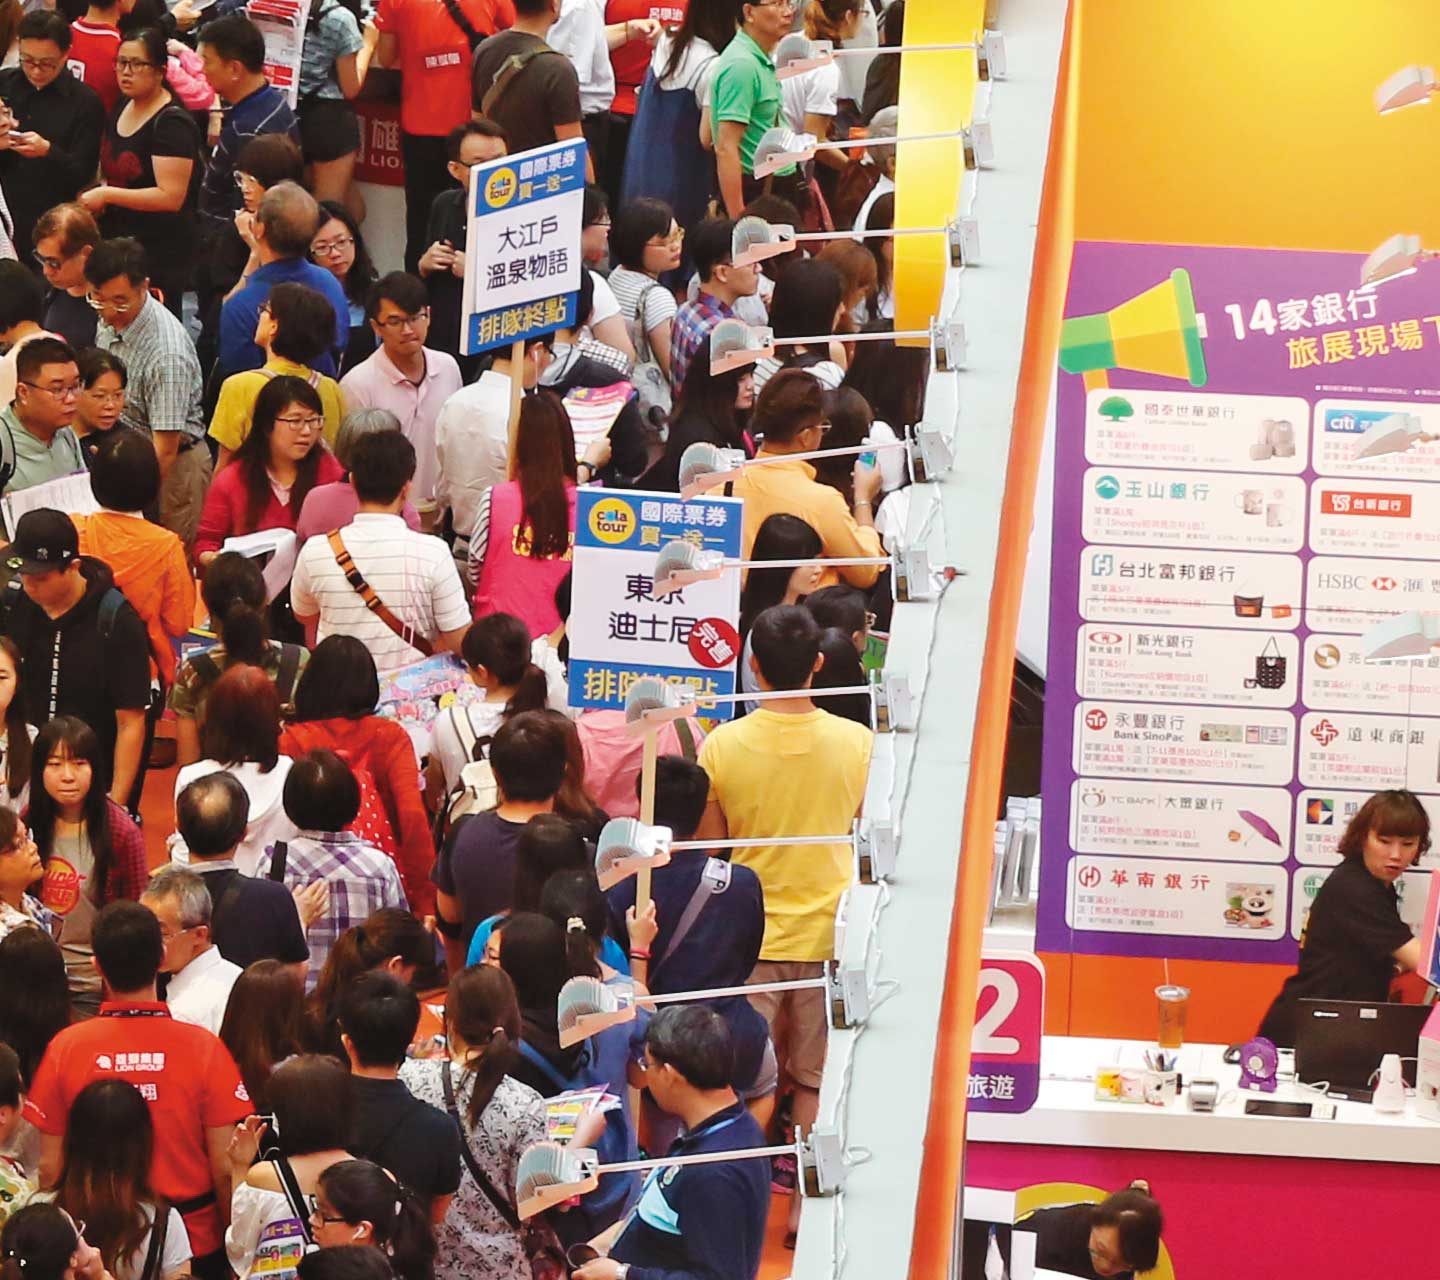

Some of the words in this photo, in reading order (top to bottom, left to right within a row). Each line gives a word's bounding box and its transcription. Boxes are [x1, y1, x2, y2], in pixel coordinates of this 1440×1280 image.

[519, 149, 577, 183] 國際票券
[498, 215, 559, 256] 大江戶
[486, 249, 569, 292] 溫泉物語
[477, 295, 568, 346] 排隊終點
[1225, 288, 1378, 341] 14家銀行
[1126, 481, 1210, 502] 玉山銀行
[640, 500, 728, 528] 國際票券
[1120, 561, 1236, 583] 台北富邦銀行
[1317, 574, 1365, 591] HSBC
[1136, 634, 1195, 649] 新光銀行
[1115, 714, 1186, 730] 永豐銀行
[1114, 731, 1140, 740] Bank
[1142, 732, 1185, 742] SinoPac
[1110, 869, 1211, 891] 華南銀行
